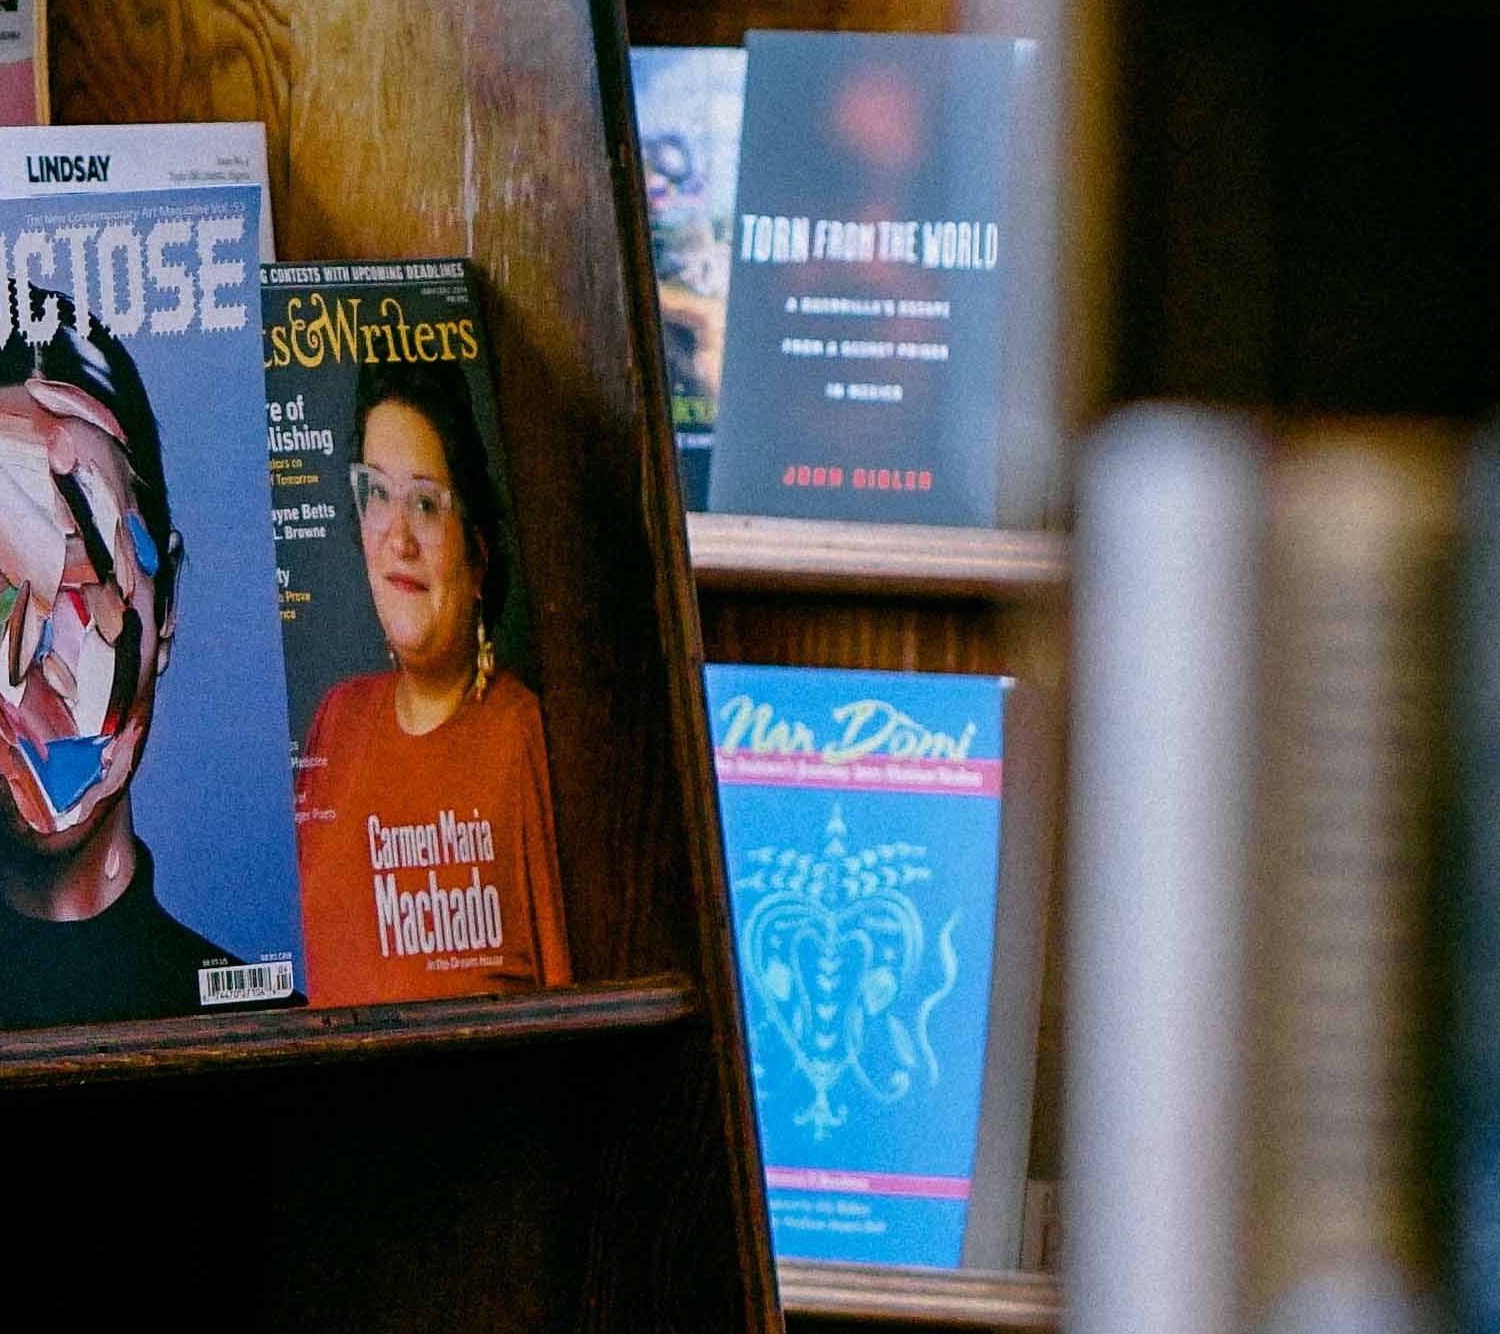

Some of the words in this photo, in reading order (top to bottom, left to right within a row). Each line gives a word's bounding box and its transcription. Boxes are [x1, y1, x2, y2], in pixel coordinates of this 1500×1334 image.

[26, 155, 111, 183] LINDSAY
[741, 214, 811, 264] TORN
[876, 219, 920, 265] THE
[921, 220, 999, 270] WORLD
[270, 266, 321, 284] CONTESTS
[323, 265, 350, 283] WITH
[352, 264, 404, 282] UPCOMING
[406, 262, 465, 280] DEADLINES
[286, 394, 305, 421] of
[301, 503, 336, 520] Betts
[284, 525, 327, 540] Browne
[367, 813, 441, 871] Carmen
[439, 807, 495, 865] Maria
[373, 866, 503, 958] Machado
